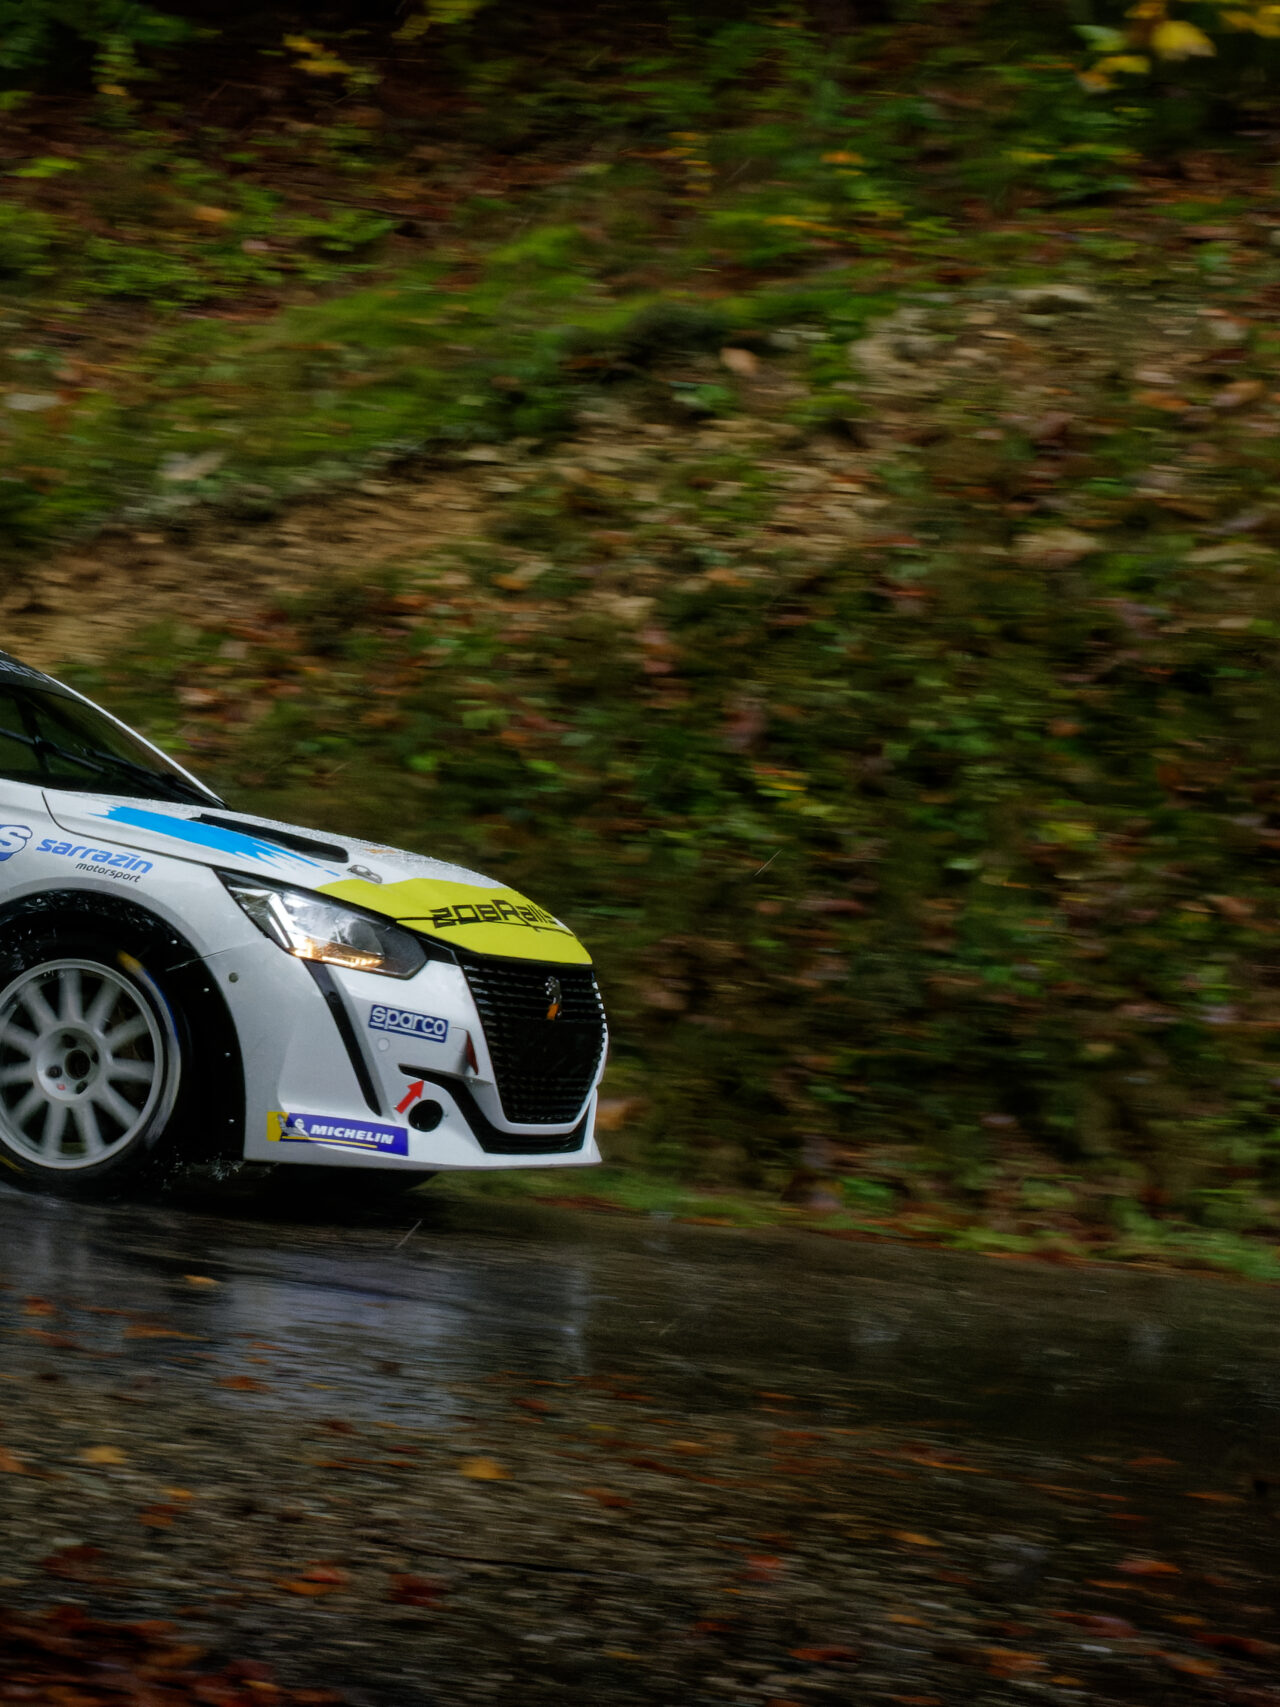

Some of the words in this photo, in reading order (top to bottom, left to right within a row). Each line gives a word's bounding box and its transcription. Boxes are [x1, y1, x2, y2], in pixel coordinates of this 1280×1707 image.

[35, 838, 154, 874] sarrazin
[75, 862, 142, 883] motorsport
[371, 1006, 447, 1035] sparco
[310, 1124, 395, 1145] MICHELIN
